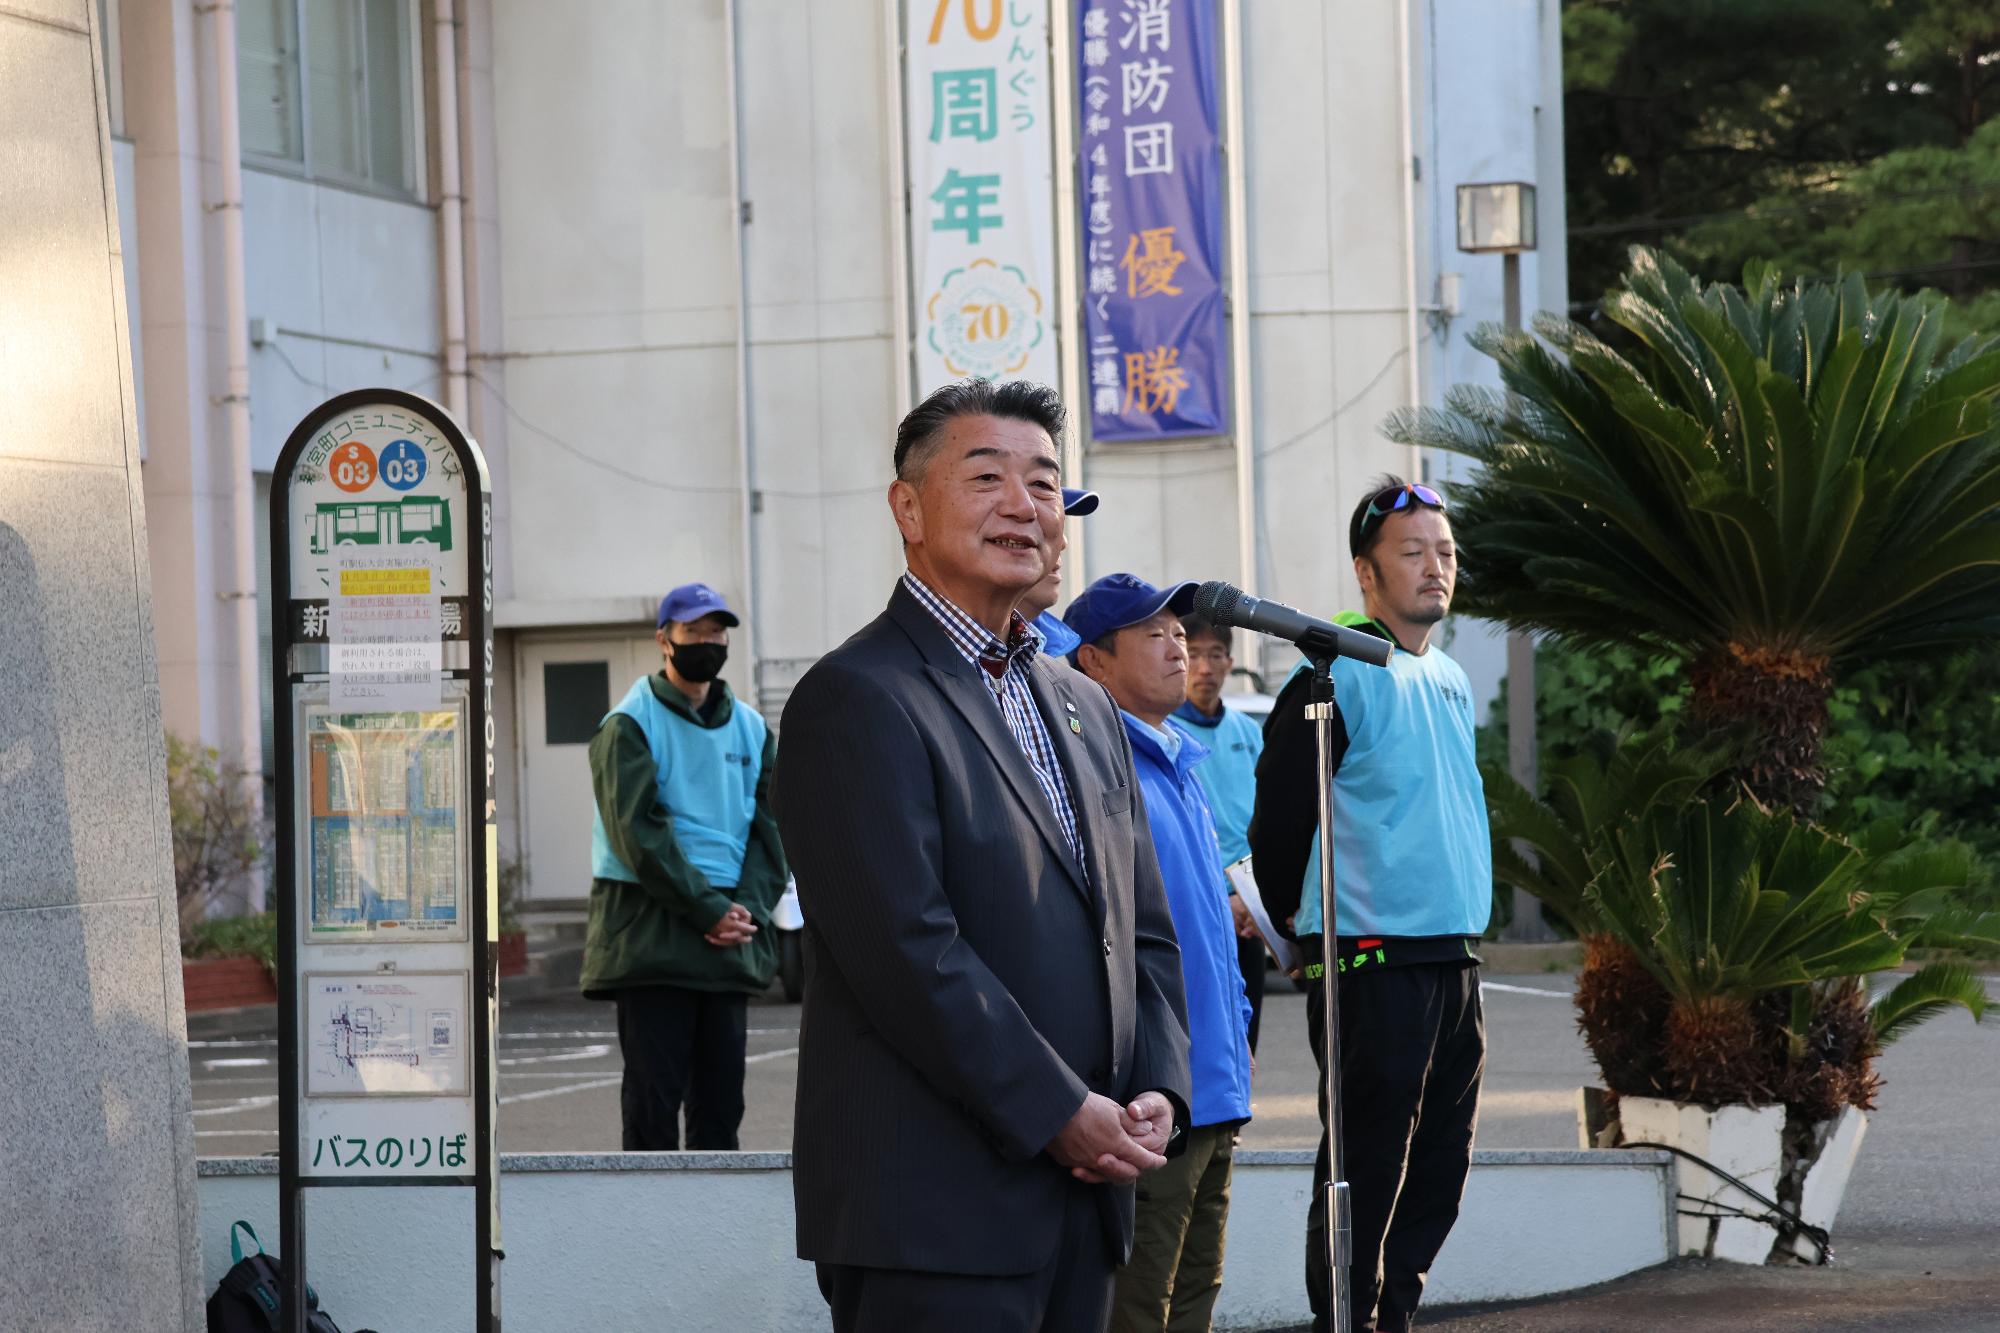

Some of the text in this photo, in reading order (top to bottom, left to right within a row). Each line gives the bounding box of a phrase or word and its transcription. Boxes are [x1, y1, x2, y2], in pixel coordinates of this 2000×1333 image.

[1007, 1, 1036, 133] しんぐう
[1118, 0, 1190, 417] 消防団 優勝
[960, 302, 1010, 343] 70
[298, 412, 461, 485] 宮町コミュニティバス
[337, 461, 371, 487] 03
[386, 459, 419, 484] 03
[481, 503, 495, 788] BUS STOP
[312, 1132, 468, 1168] バスのりば
